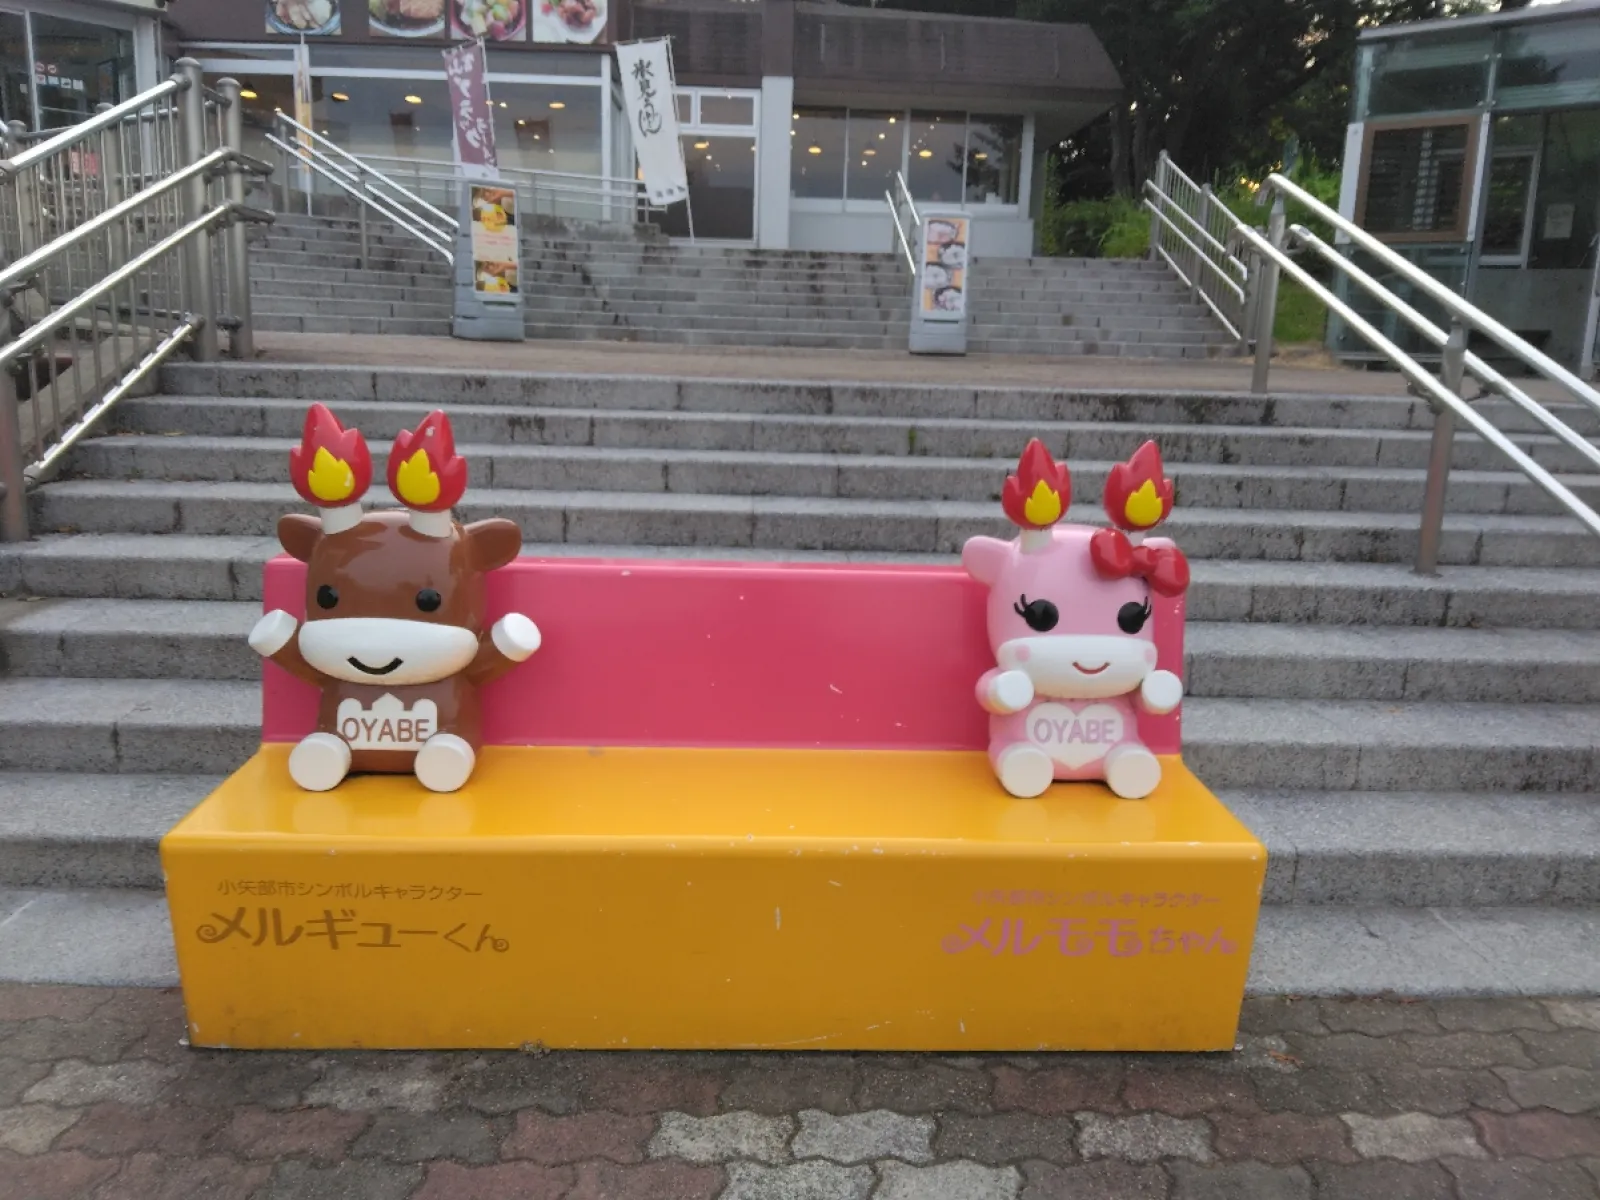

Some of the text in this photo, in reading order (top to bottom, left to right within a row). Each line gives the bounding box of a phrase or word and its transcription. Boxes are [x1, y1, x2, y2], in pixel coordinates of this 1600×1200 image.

[342, 718, 430, 742] OYABE
[1033, 718, 1115, 744] OYABE
[217, 879, 483, 901] 小矢部市シンボルキャラクター
[196, 907, 510, 953] メルギューくん
[941, 917, 1239, 957] メルモモちゃん
